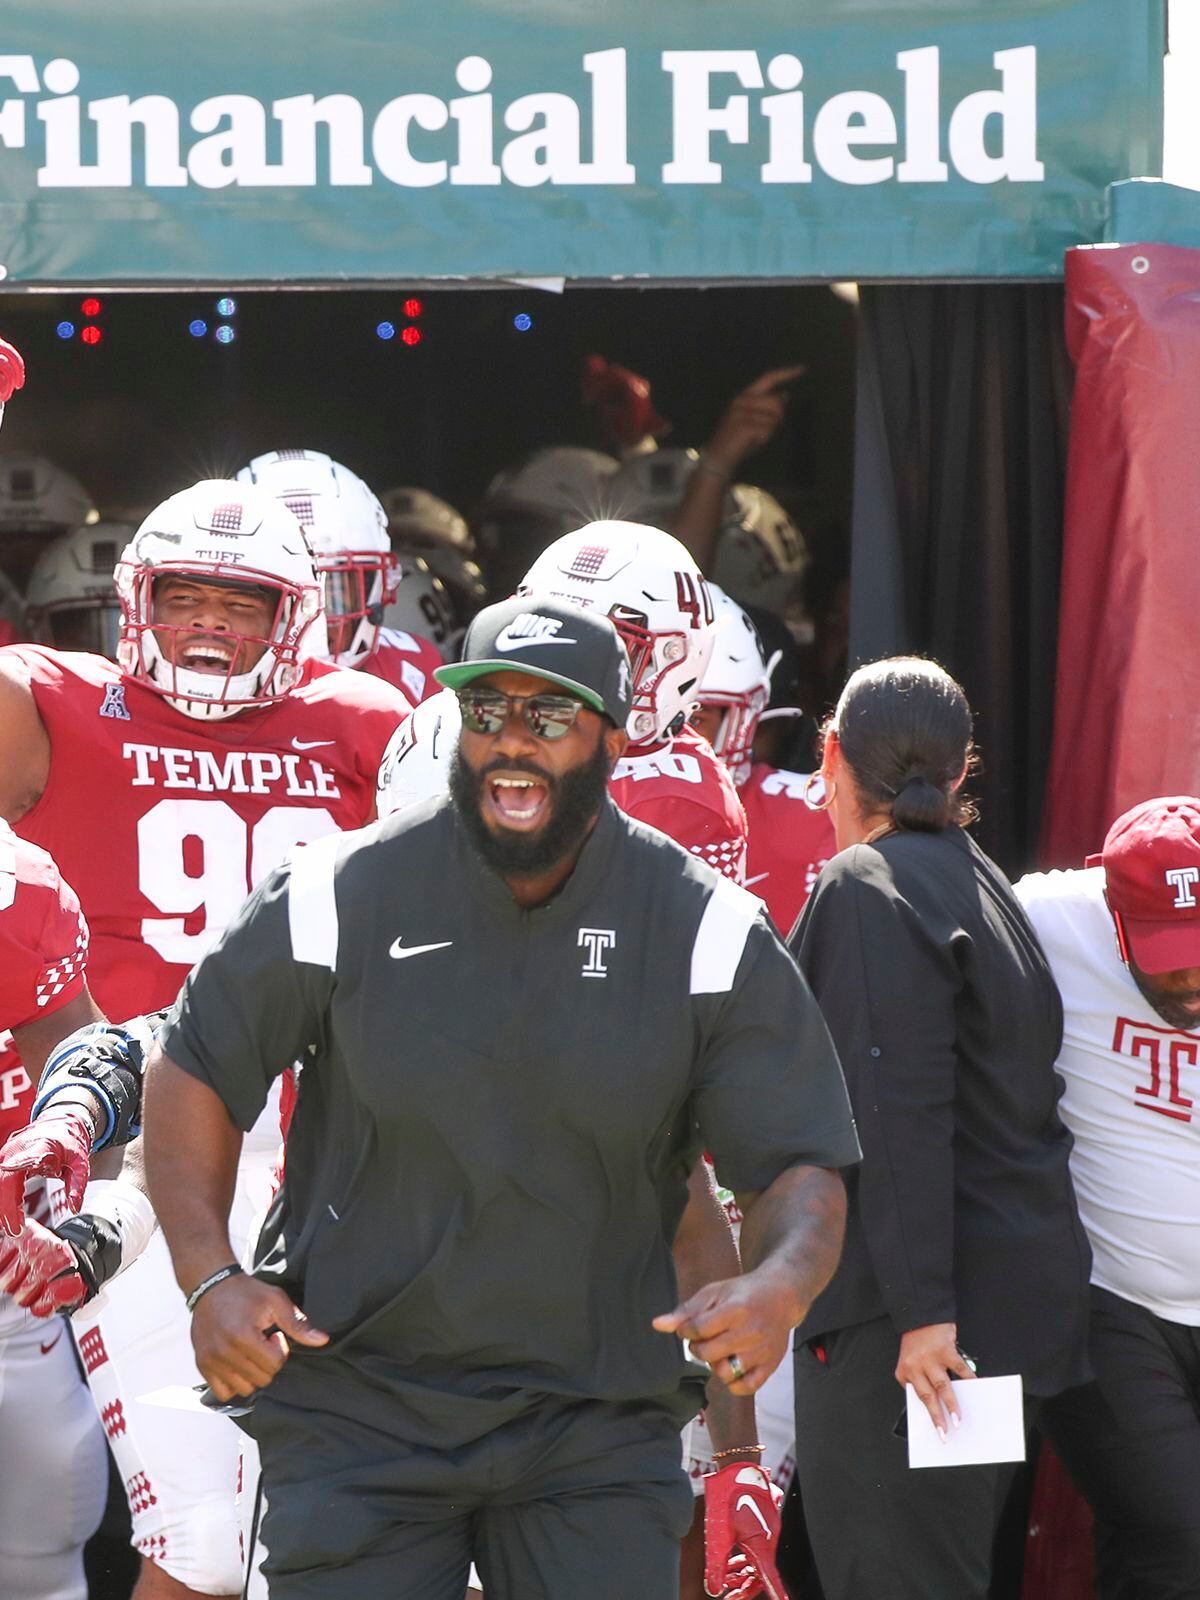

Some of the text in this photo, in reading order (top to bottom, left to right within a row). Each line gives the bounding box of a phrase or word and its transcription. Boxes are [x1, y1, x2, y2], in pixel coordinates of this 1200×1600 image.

[661, 45, 1045, 184] Field
[195, 549, 245, 563] TUFF
[507, 613, 564, 639] NIKE
[122, 742, 341, 799] TEMPLE
[611, 753, 703, 784] 40
[1165, 867, 1199, 908] T
[577, 928, 616, 978] T
